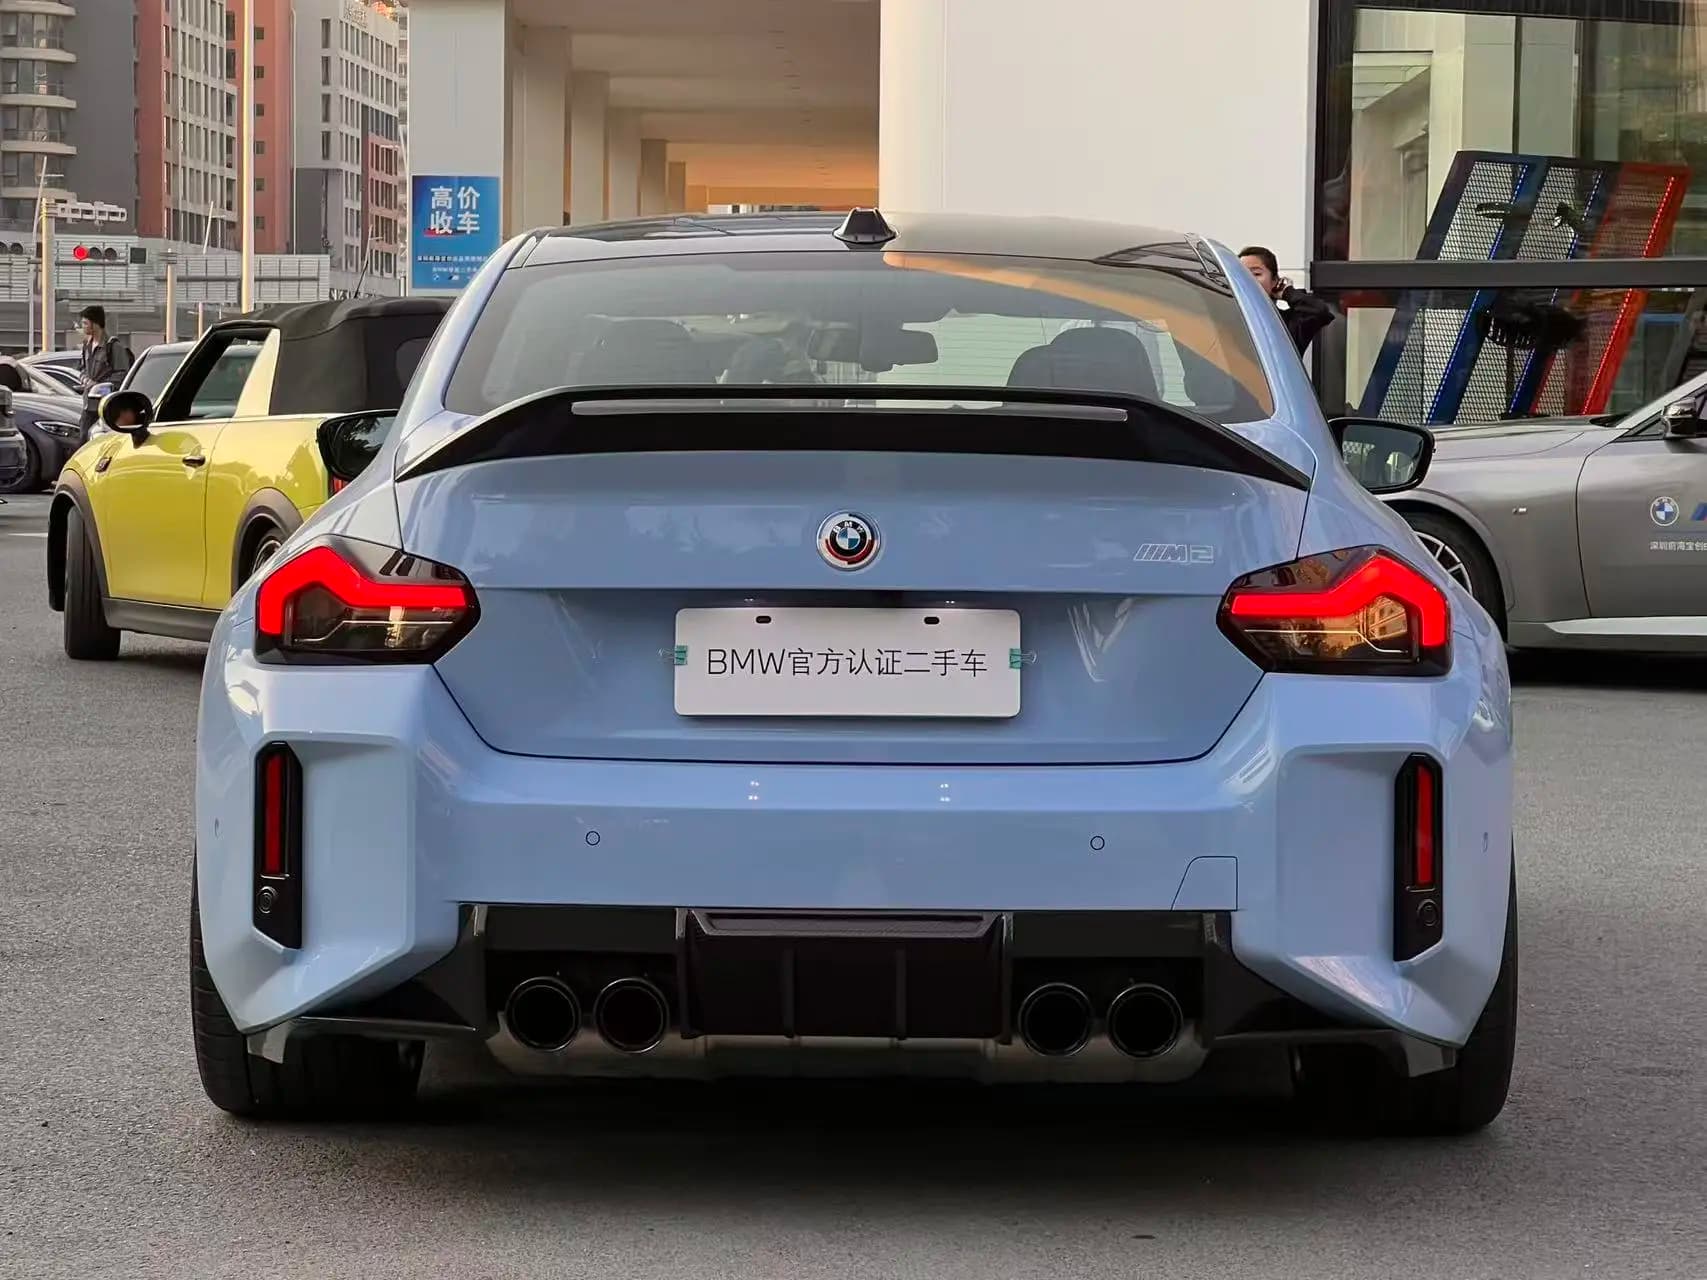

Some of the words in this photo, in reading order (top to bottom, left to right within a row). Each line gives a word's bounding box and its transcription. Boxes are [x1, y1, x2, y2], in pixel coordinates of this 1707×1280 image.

[430, 185, 481, 210] 高价
[430, 211, 481, 235] 收车
[1134, 543, 1214, 564] M2
[707, 647, 989, 678] BMW官方认证二手车
